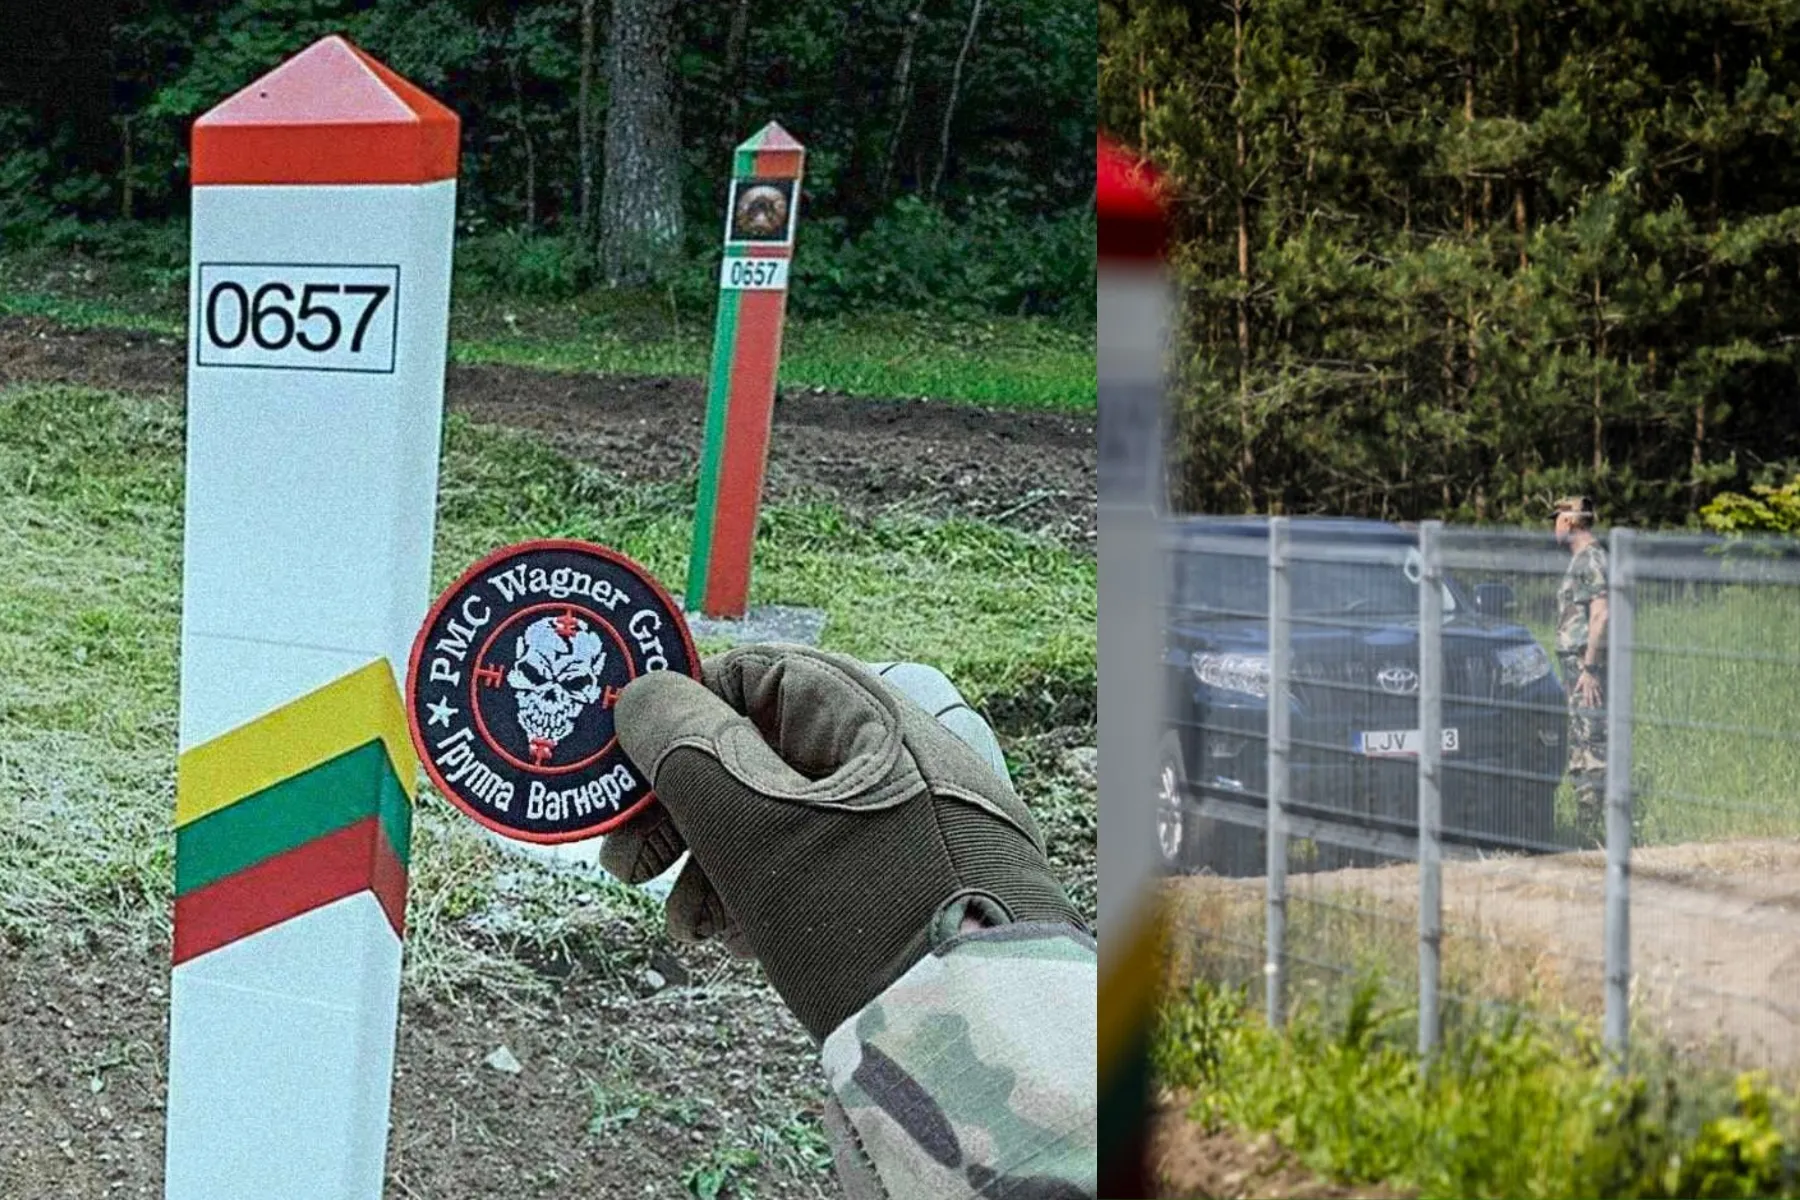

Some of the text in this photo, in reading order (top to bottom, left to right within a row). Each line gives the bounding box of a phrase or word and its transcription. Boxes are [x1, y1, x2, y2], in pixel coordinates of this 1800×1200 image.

[731, 261, 778, 285] 0657
[206, 281, 391, 353] 0657
[429, 563, 669, 687] PMC Wagner Gro
[436, 727, 637, 821] Группа Вагнера
